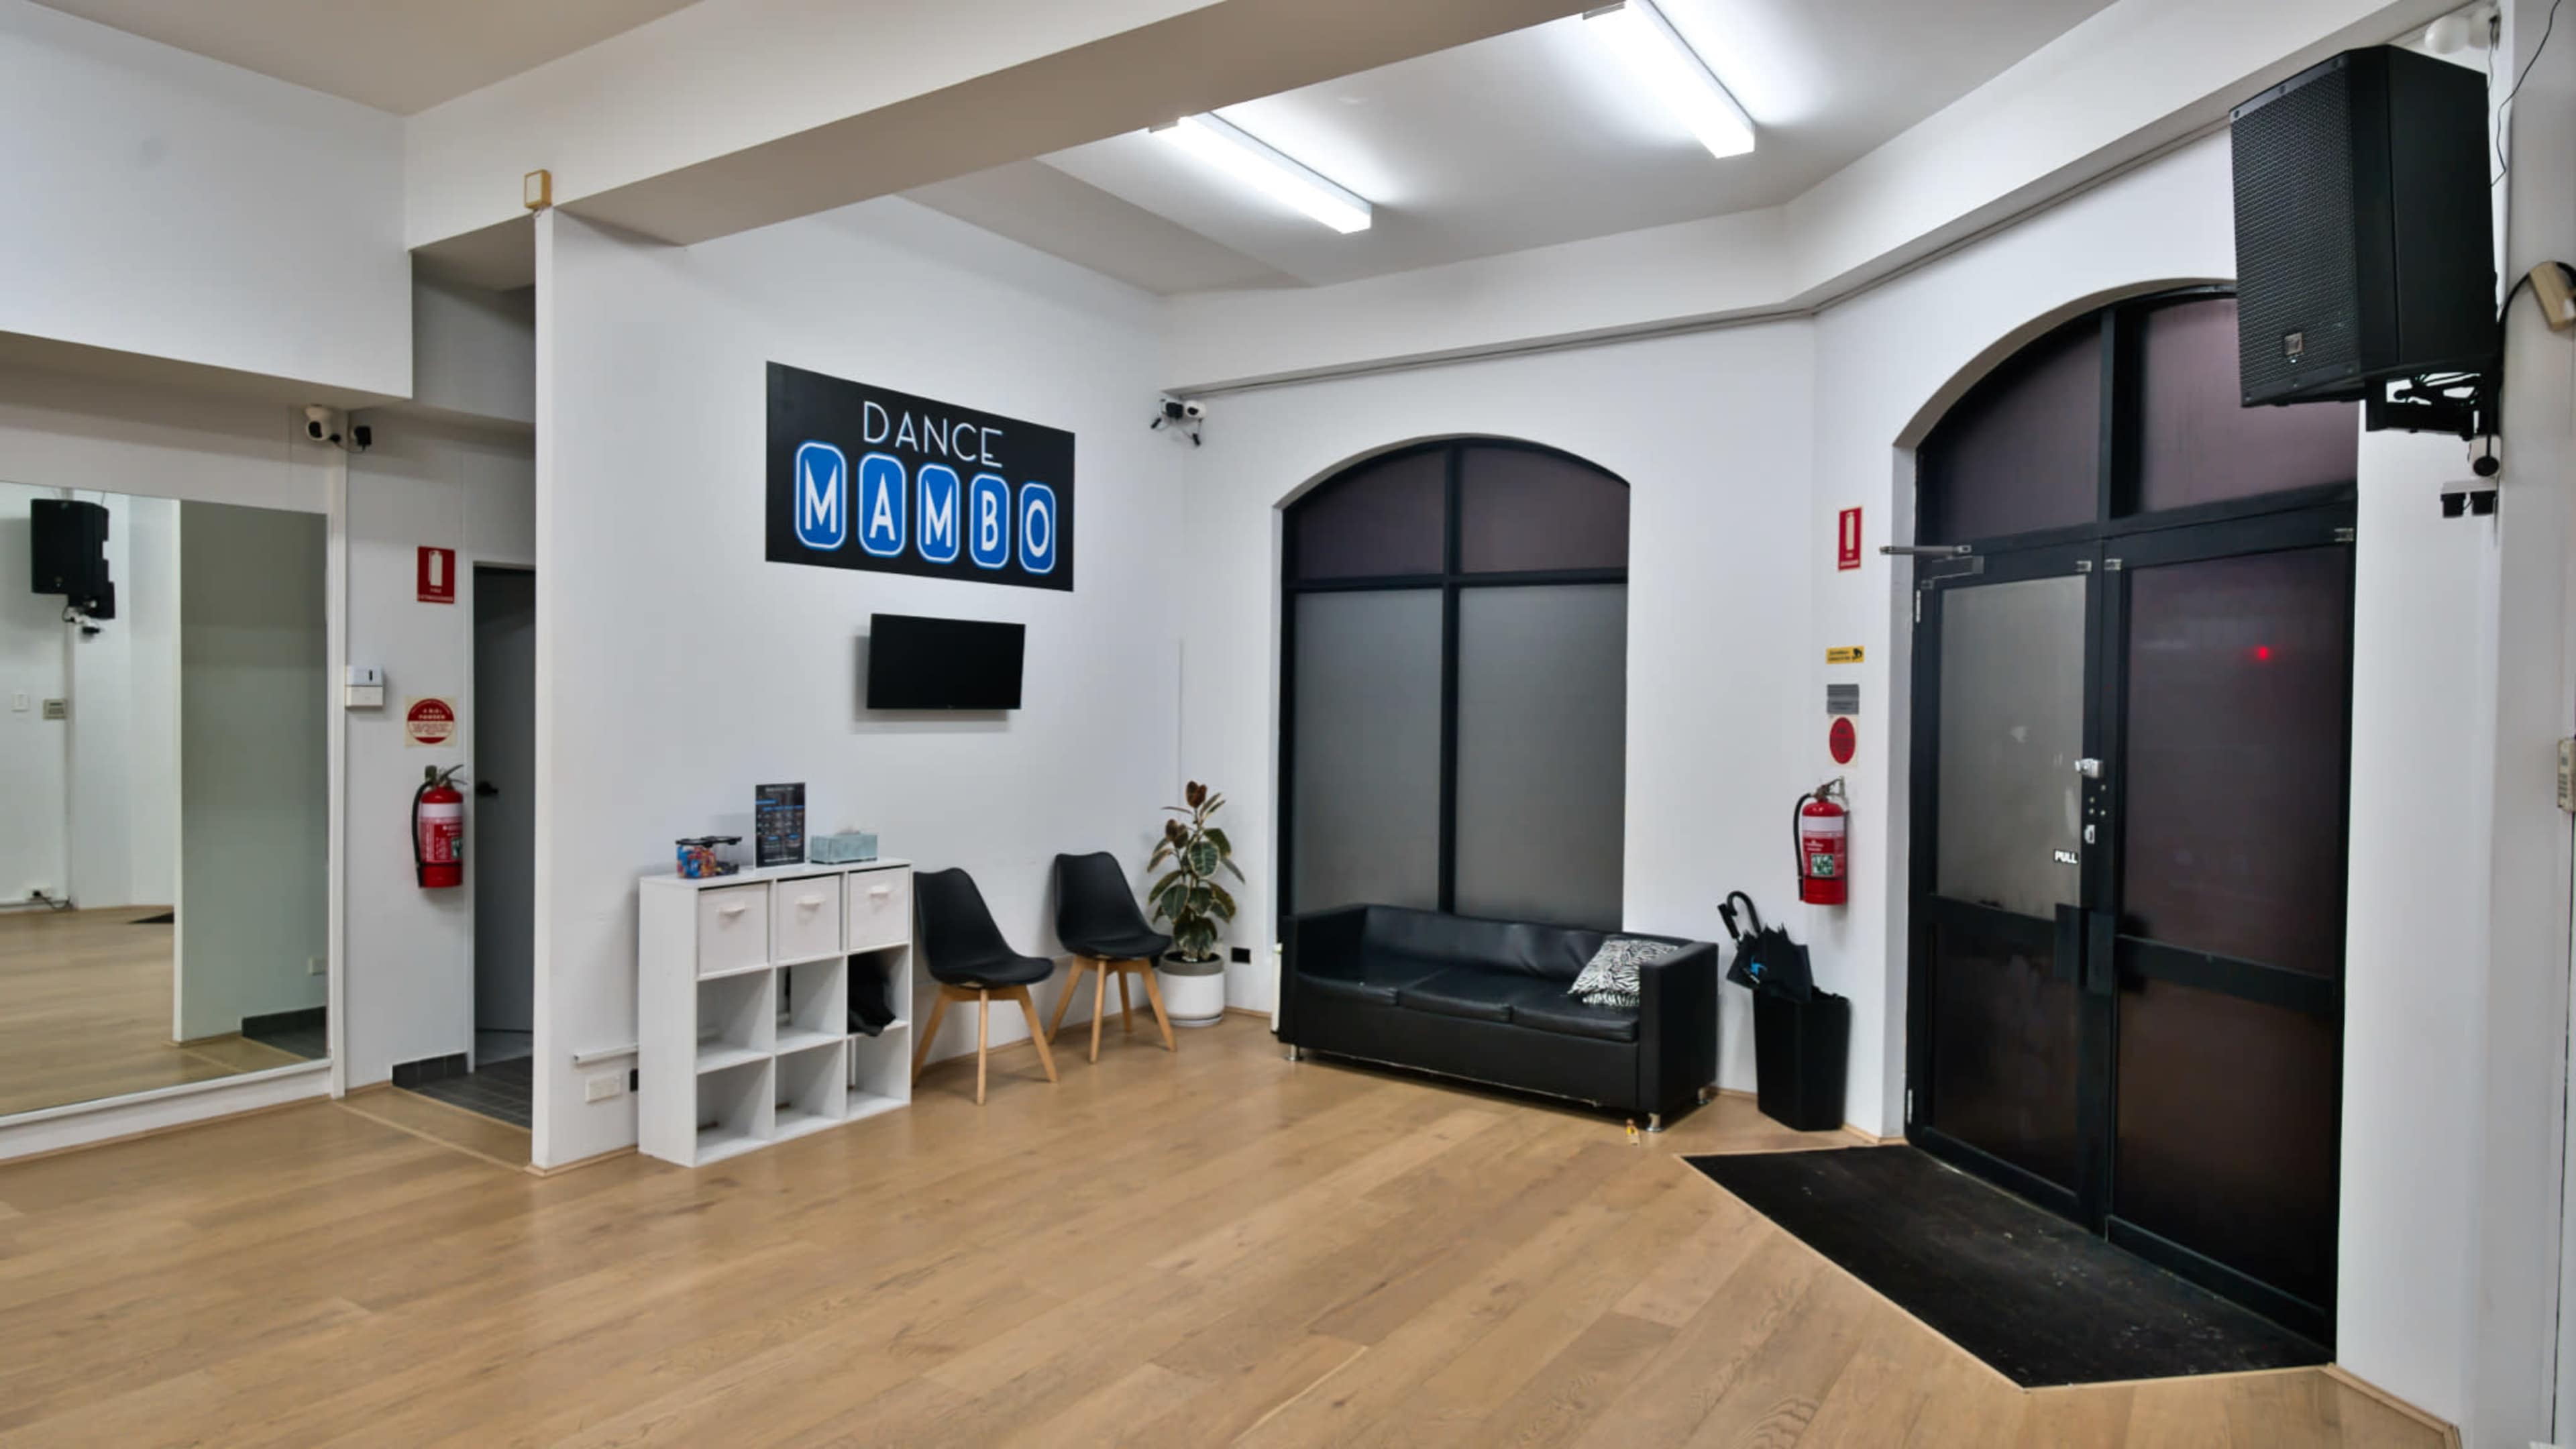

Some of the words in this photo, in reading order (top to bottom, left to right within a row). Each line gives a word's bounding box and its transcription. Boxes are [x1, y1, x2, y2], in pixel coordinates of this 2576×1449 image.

[863, 400, 1003, 468] DANCE
[804, 458, 1051, 557] MAMBO
[2055, 850, 2078, 864] PULL
